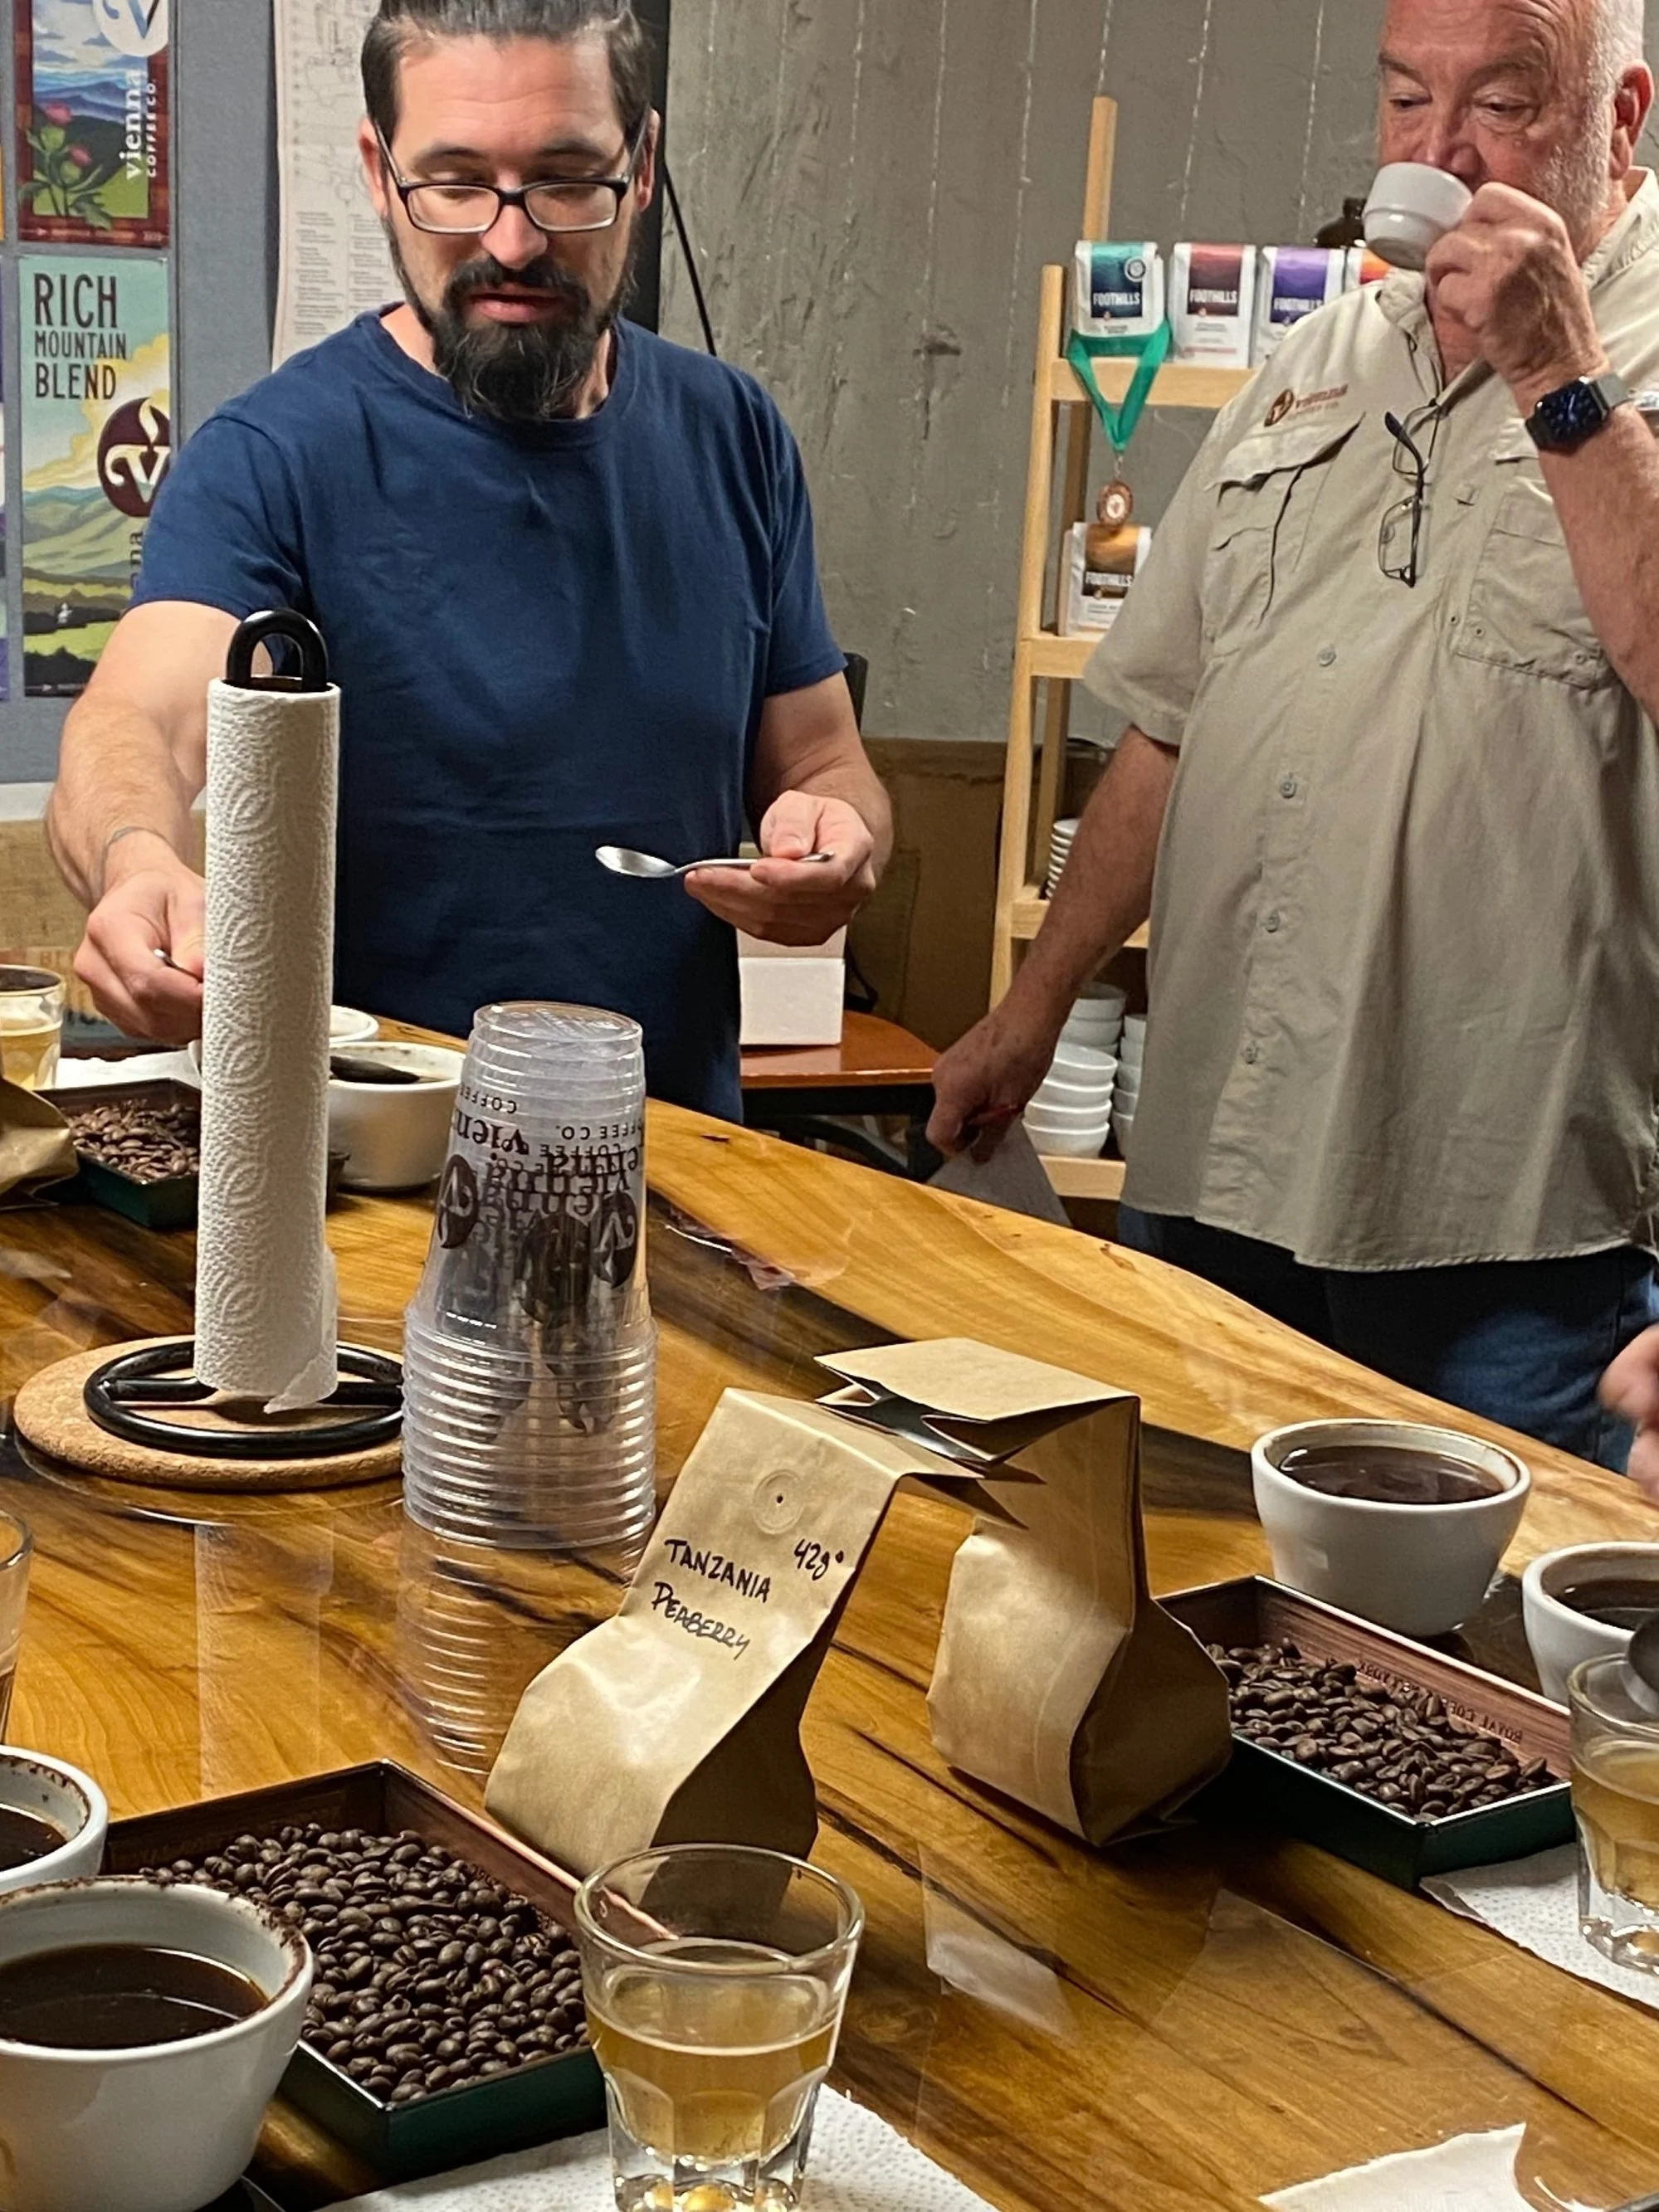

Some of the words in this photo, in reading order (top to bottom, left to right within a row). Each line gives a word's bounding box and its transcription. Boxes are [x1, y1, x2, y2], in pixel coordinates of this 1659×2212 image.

[120, 70, 148, 181] vienna
[34, 274, 117, 329] RICH
[34, 330, 127, 360] MOUNTAIN
[35, 363, 116, 401] BLEND
[555, 1124, 591, 1141] CO.
[664, 1538, 772, 1603] TANZANIA
